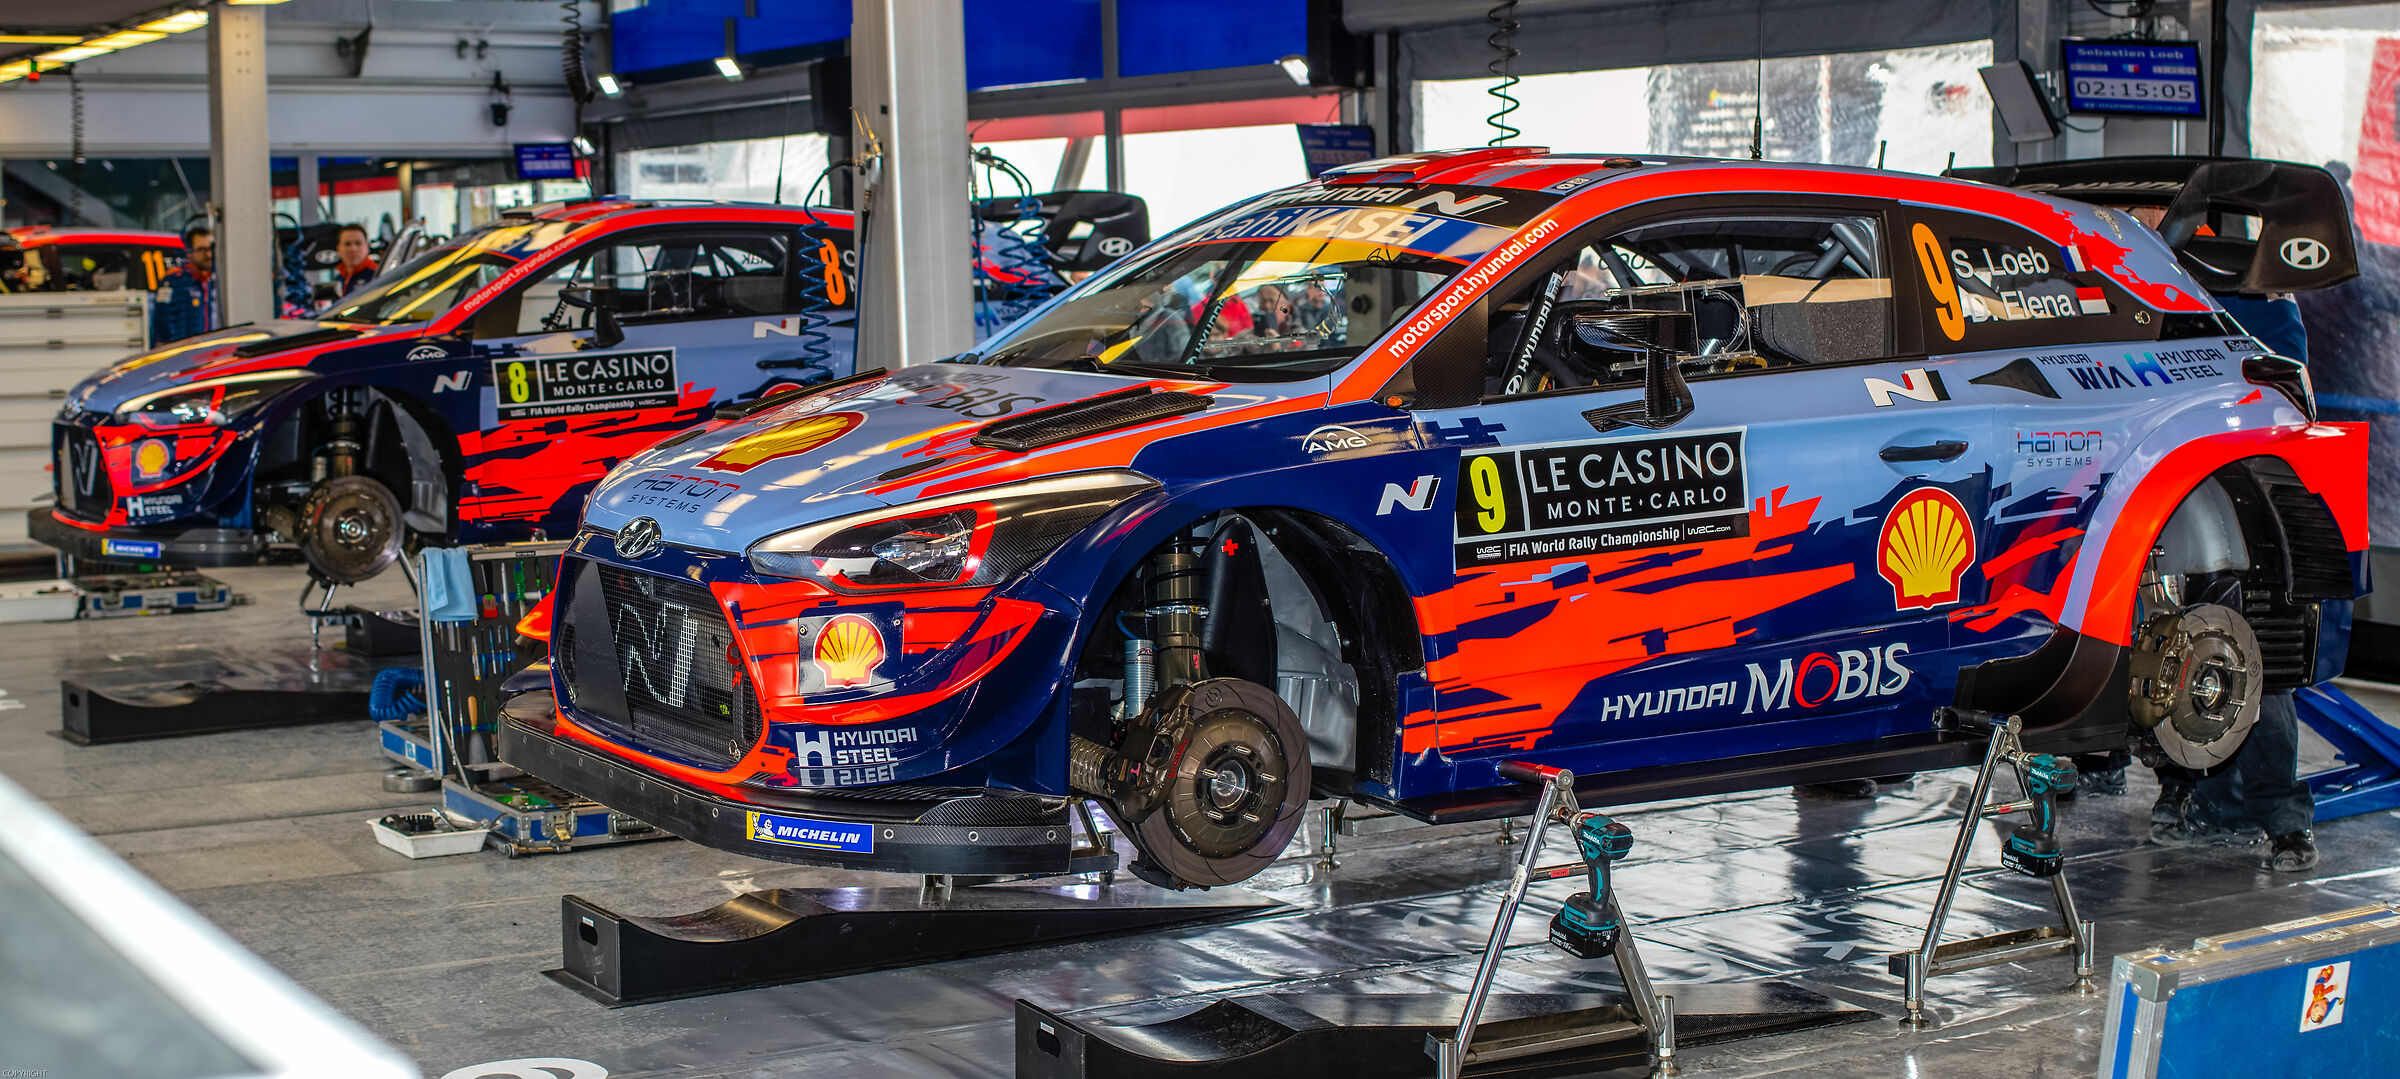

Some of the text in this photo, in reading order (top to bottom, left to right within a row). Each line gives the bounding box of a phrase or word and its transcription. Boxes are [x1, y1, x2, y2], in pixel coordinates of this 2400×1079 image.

[2078, 48, 2184, 59] Sebastien Loeb
[2077, 80, 2192, 100] 02:15:05
[141, 250, 166, 291] 11
[1983, 246, 2050, 276] Loeb
[463, 237, 577, 312] motorsport.hyundai.com
[819, 238, 846, 306] 8
[1912, 222, 1965, 341] 9
[1389, 218, 1559, 358] motorsport.hyundai.com
[2000, 290, 2076, 321] Elena
[1518, 300, 1552, 373] HYUNDAI
[409, 351, 446, 361] AMG
[2036, 353, 2092, 365] HYUNDAI
[2155, 348, 2225, 366] HYUNDAI
[543, 354, 669, 383] LE CASINO
[2169, 364, 2223, 382] STEEL
[507, 361, 529, 403] 8
[530, 407, 543, 416] FIA
[544, 406, 564, 415] World
[566, 404, 584, 413] Rally
[585, 400, 635, 411] Championship
[1308, 436, 1368, 453] AMG
[1528, 442, 1734, 494] LE CASINO
[2027, 456, 2092, 467] SYSTEMS
[144, 495, 183, 505] HYUNDAI
[627, 494, 701, 514] SYSTEMS
[1470, 456, 1506, 533] 9
[145, 505, 174, 515] STEEL
[1509, 544, 1529, 556] FIA
[1532, 540, 1565, 555] World
[1569, 537, 1598, 551] Rally
[1601, 527, 1680, 547] Championship
[1601, 642, 1911, 722] HYUNDAI MOBIS
[834, 727, 917, 747] HYUNDAI
[836, 748, 897, 765] STEEL
[777, 825, 861, 844] MICHELIN
